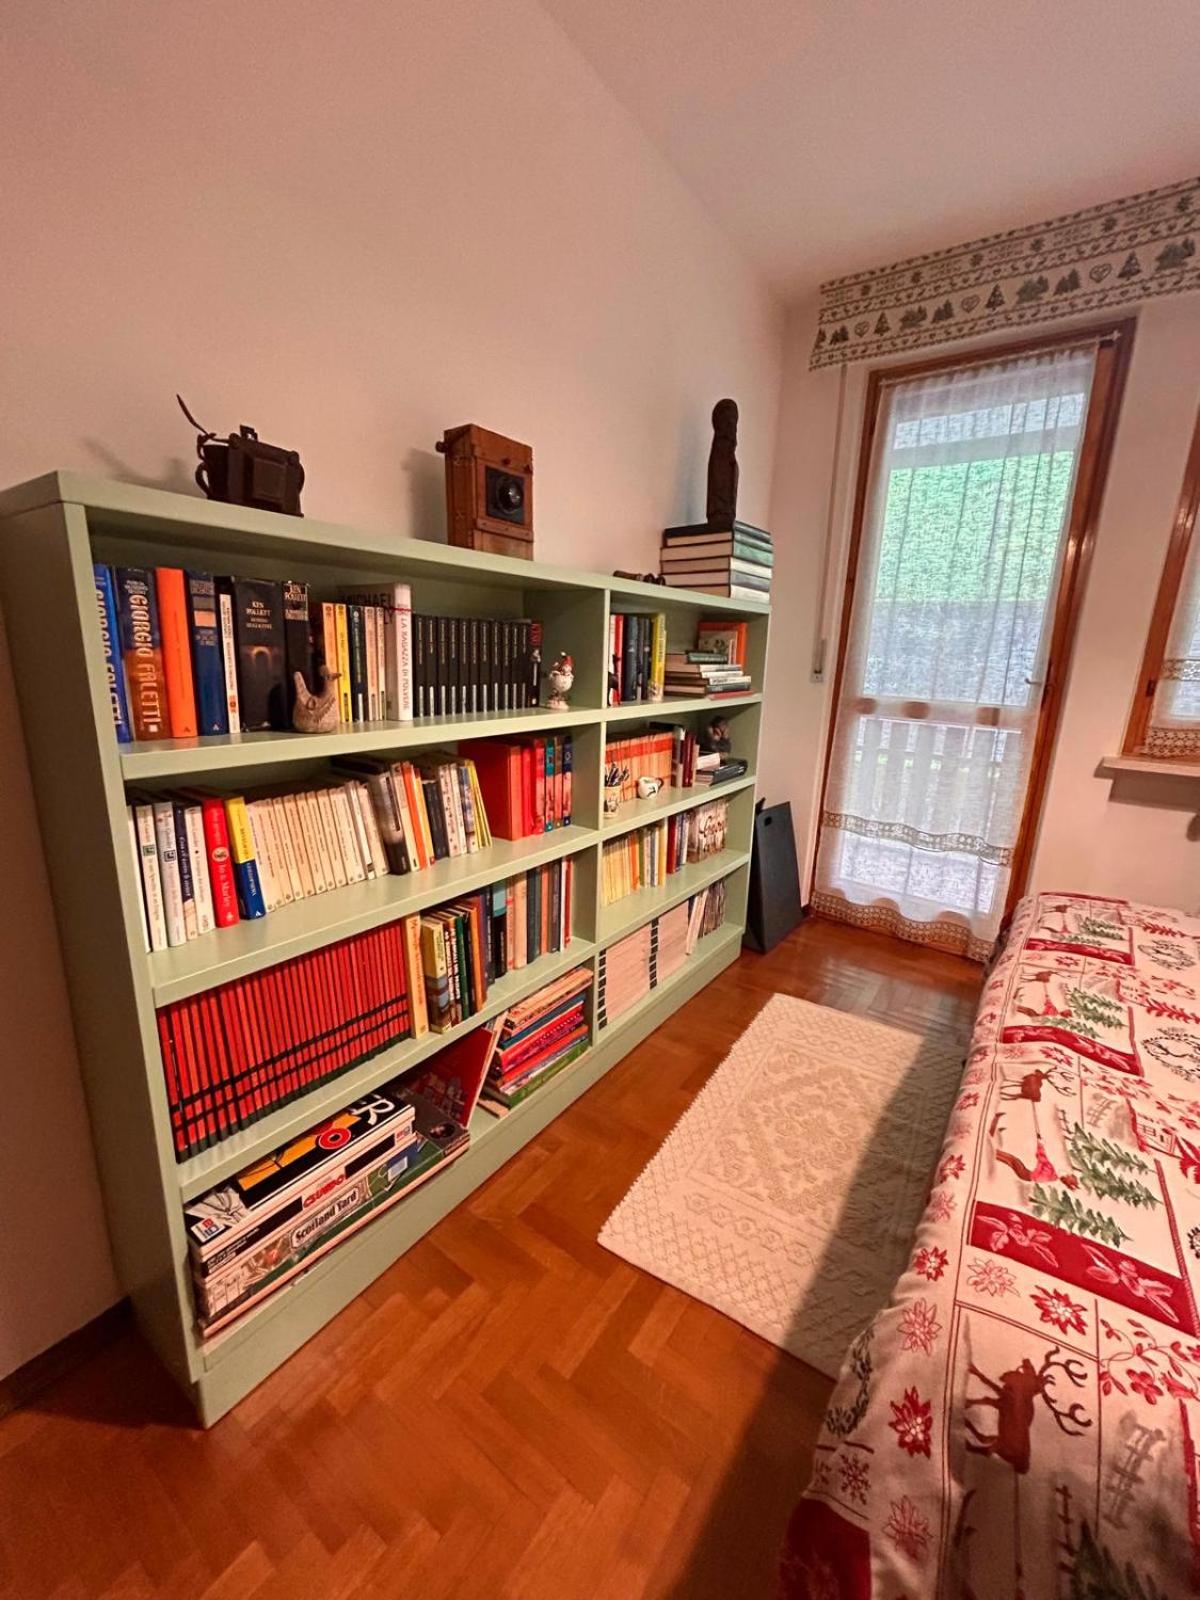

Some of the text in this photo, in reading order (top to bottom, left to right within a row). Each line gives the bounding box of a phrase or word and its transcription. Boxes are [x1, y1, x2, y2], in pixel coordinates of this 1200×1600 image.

[129, 594, 153, 656] GIORGIO
[137, 663, 162, 723] FALETTI
[295, 1190, 356, 1239] Scotland Yard
